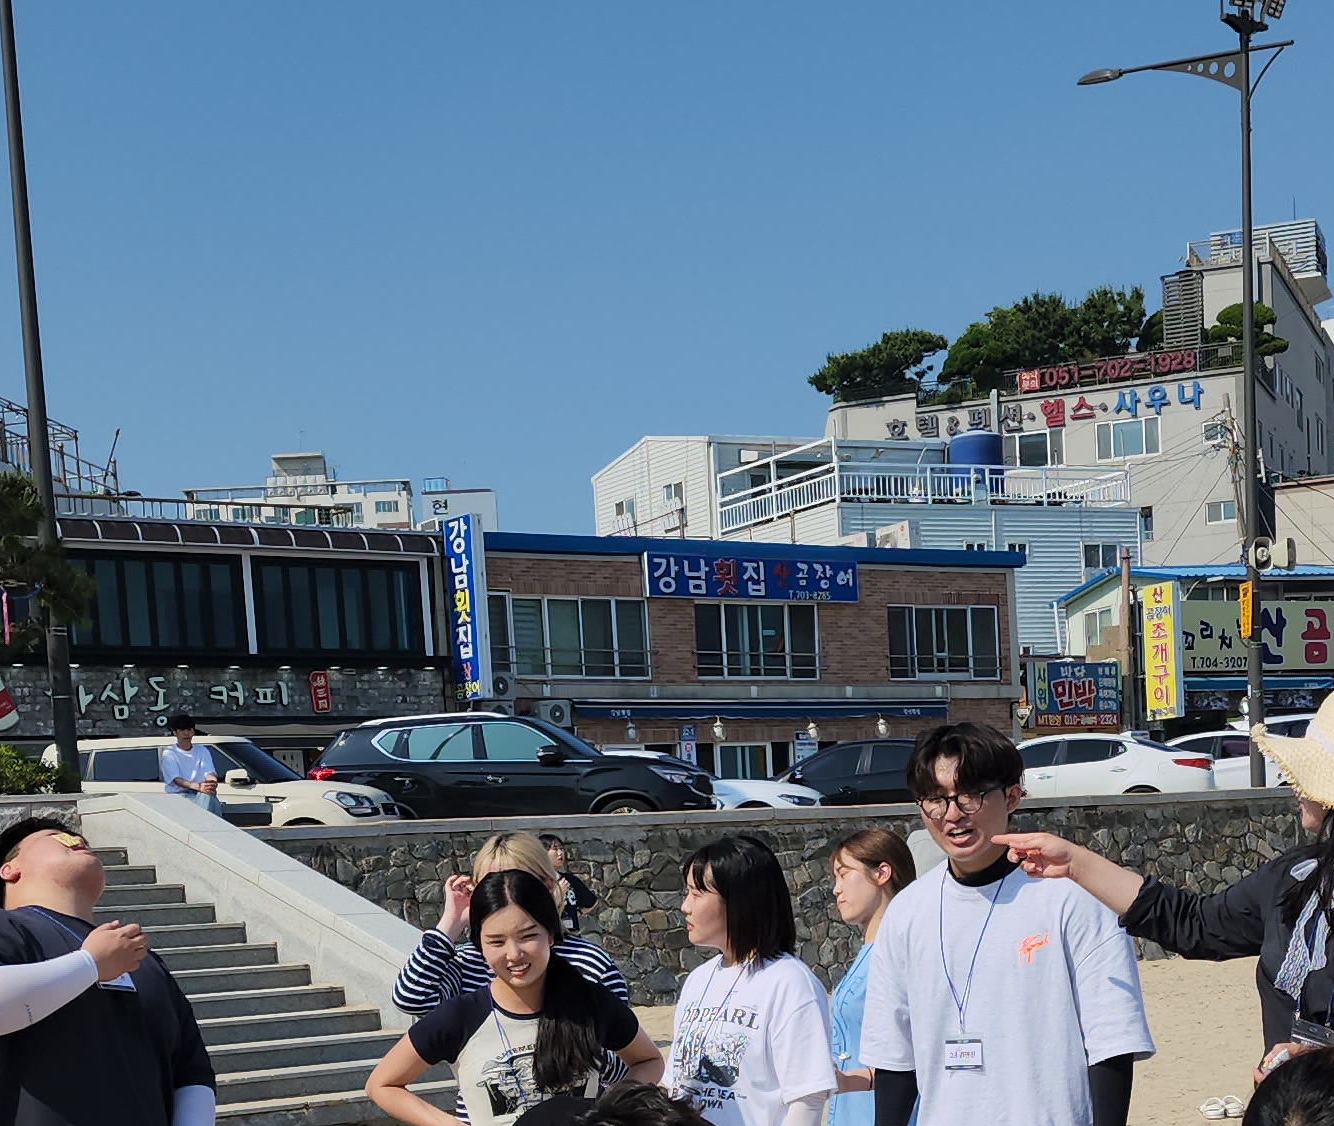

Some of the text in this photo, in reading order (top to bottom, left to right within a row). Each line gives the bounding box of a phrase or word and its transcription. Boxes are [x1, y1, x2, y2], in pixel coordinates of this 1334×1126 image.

[1045, 349, 1197, 387] 051-702-1928
[447, 517, 474, 660] 강남횟집
[652, 555, 767, 597] 강남횟집
[795, 561, 854, 589] 곰장어
[1060, 666, 1086, 677] 바다
[1150, 622, 1170, 706] 조개구이
[209, 681, 290, 707] 커피
[1051, 678, 1097, 711] 민박
